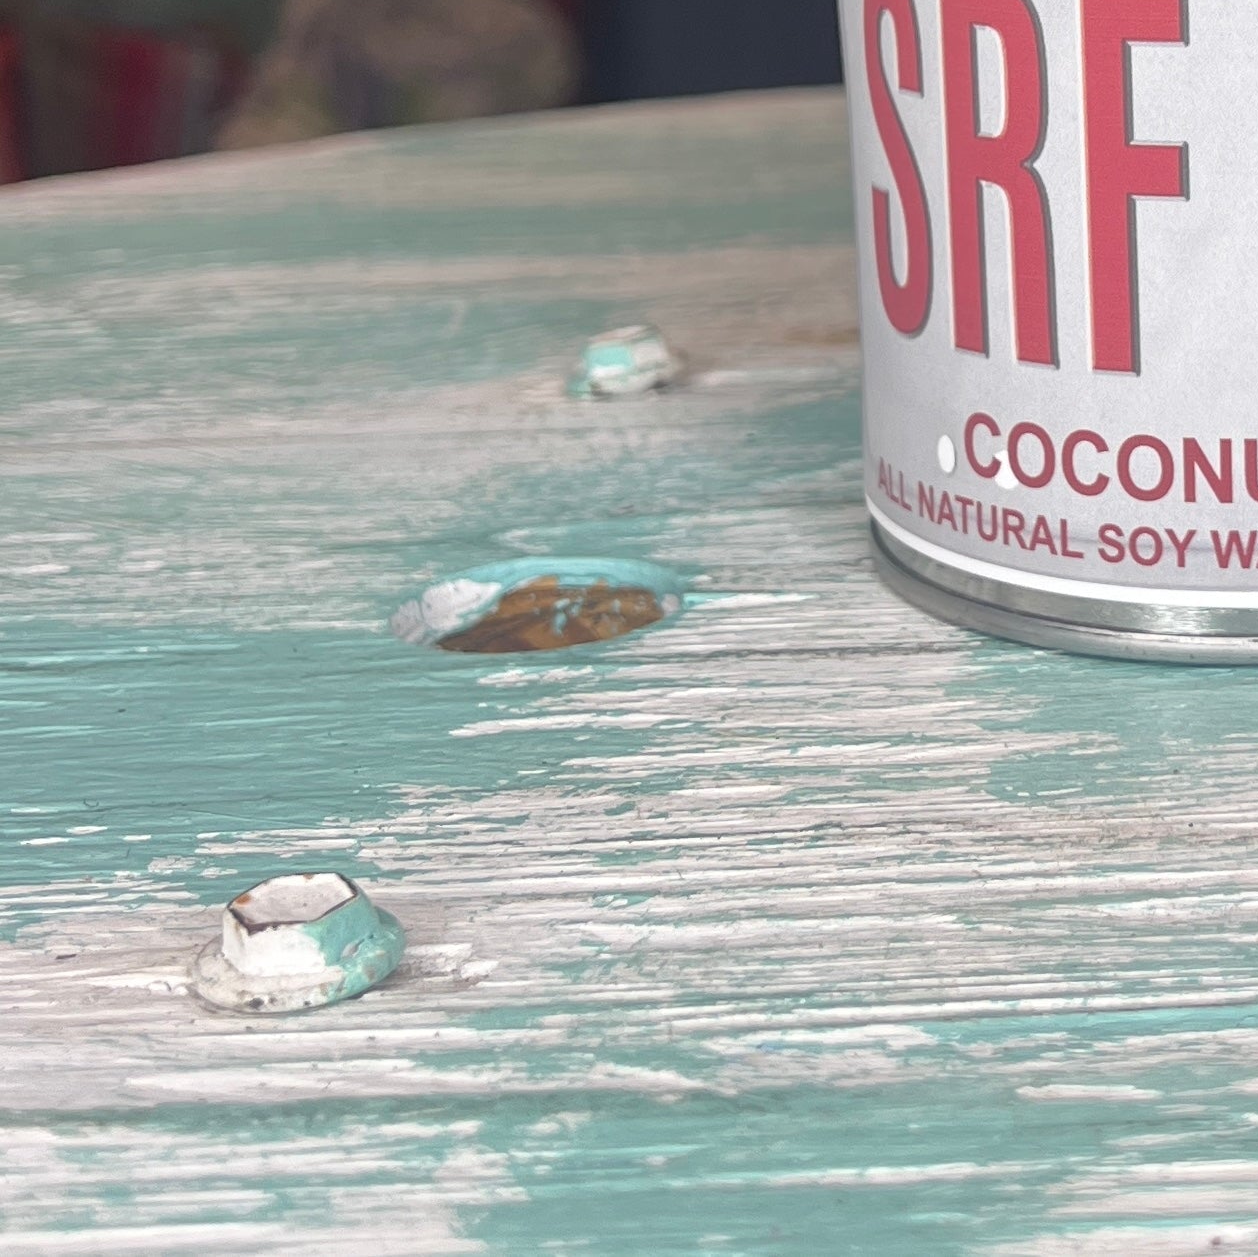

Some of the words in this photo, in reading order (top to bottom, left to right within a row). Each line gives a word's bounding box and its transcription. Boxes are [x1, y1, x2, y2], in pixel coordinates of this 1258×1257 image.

[878, 456, 912, 512] ALL
[918, 480, 1084, 559] NATURAL
[1098, 523, 1196, 569] SOY
